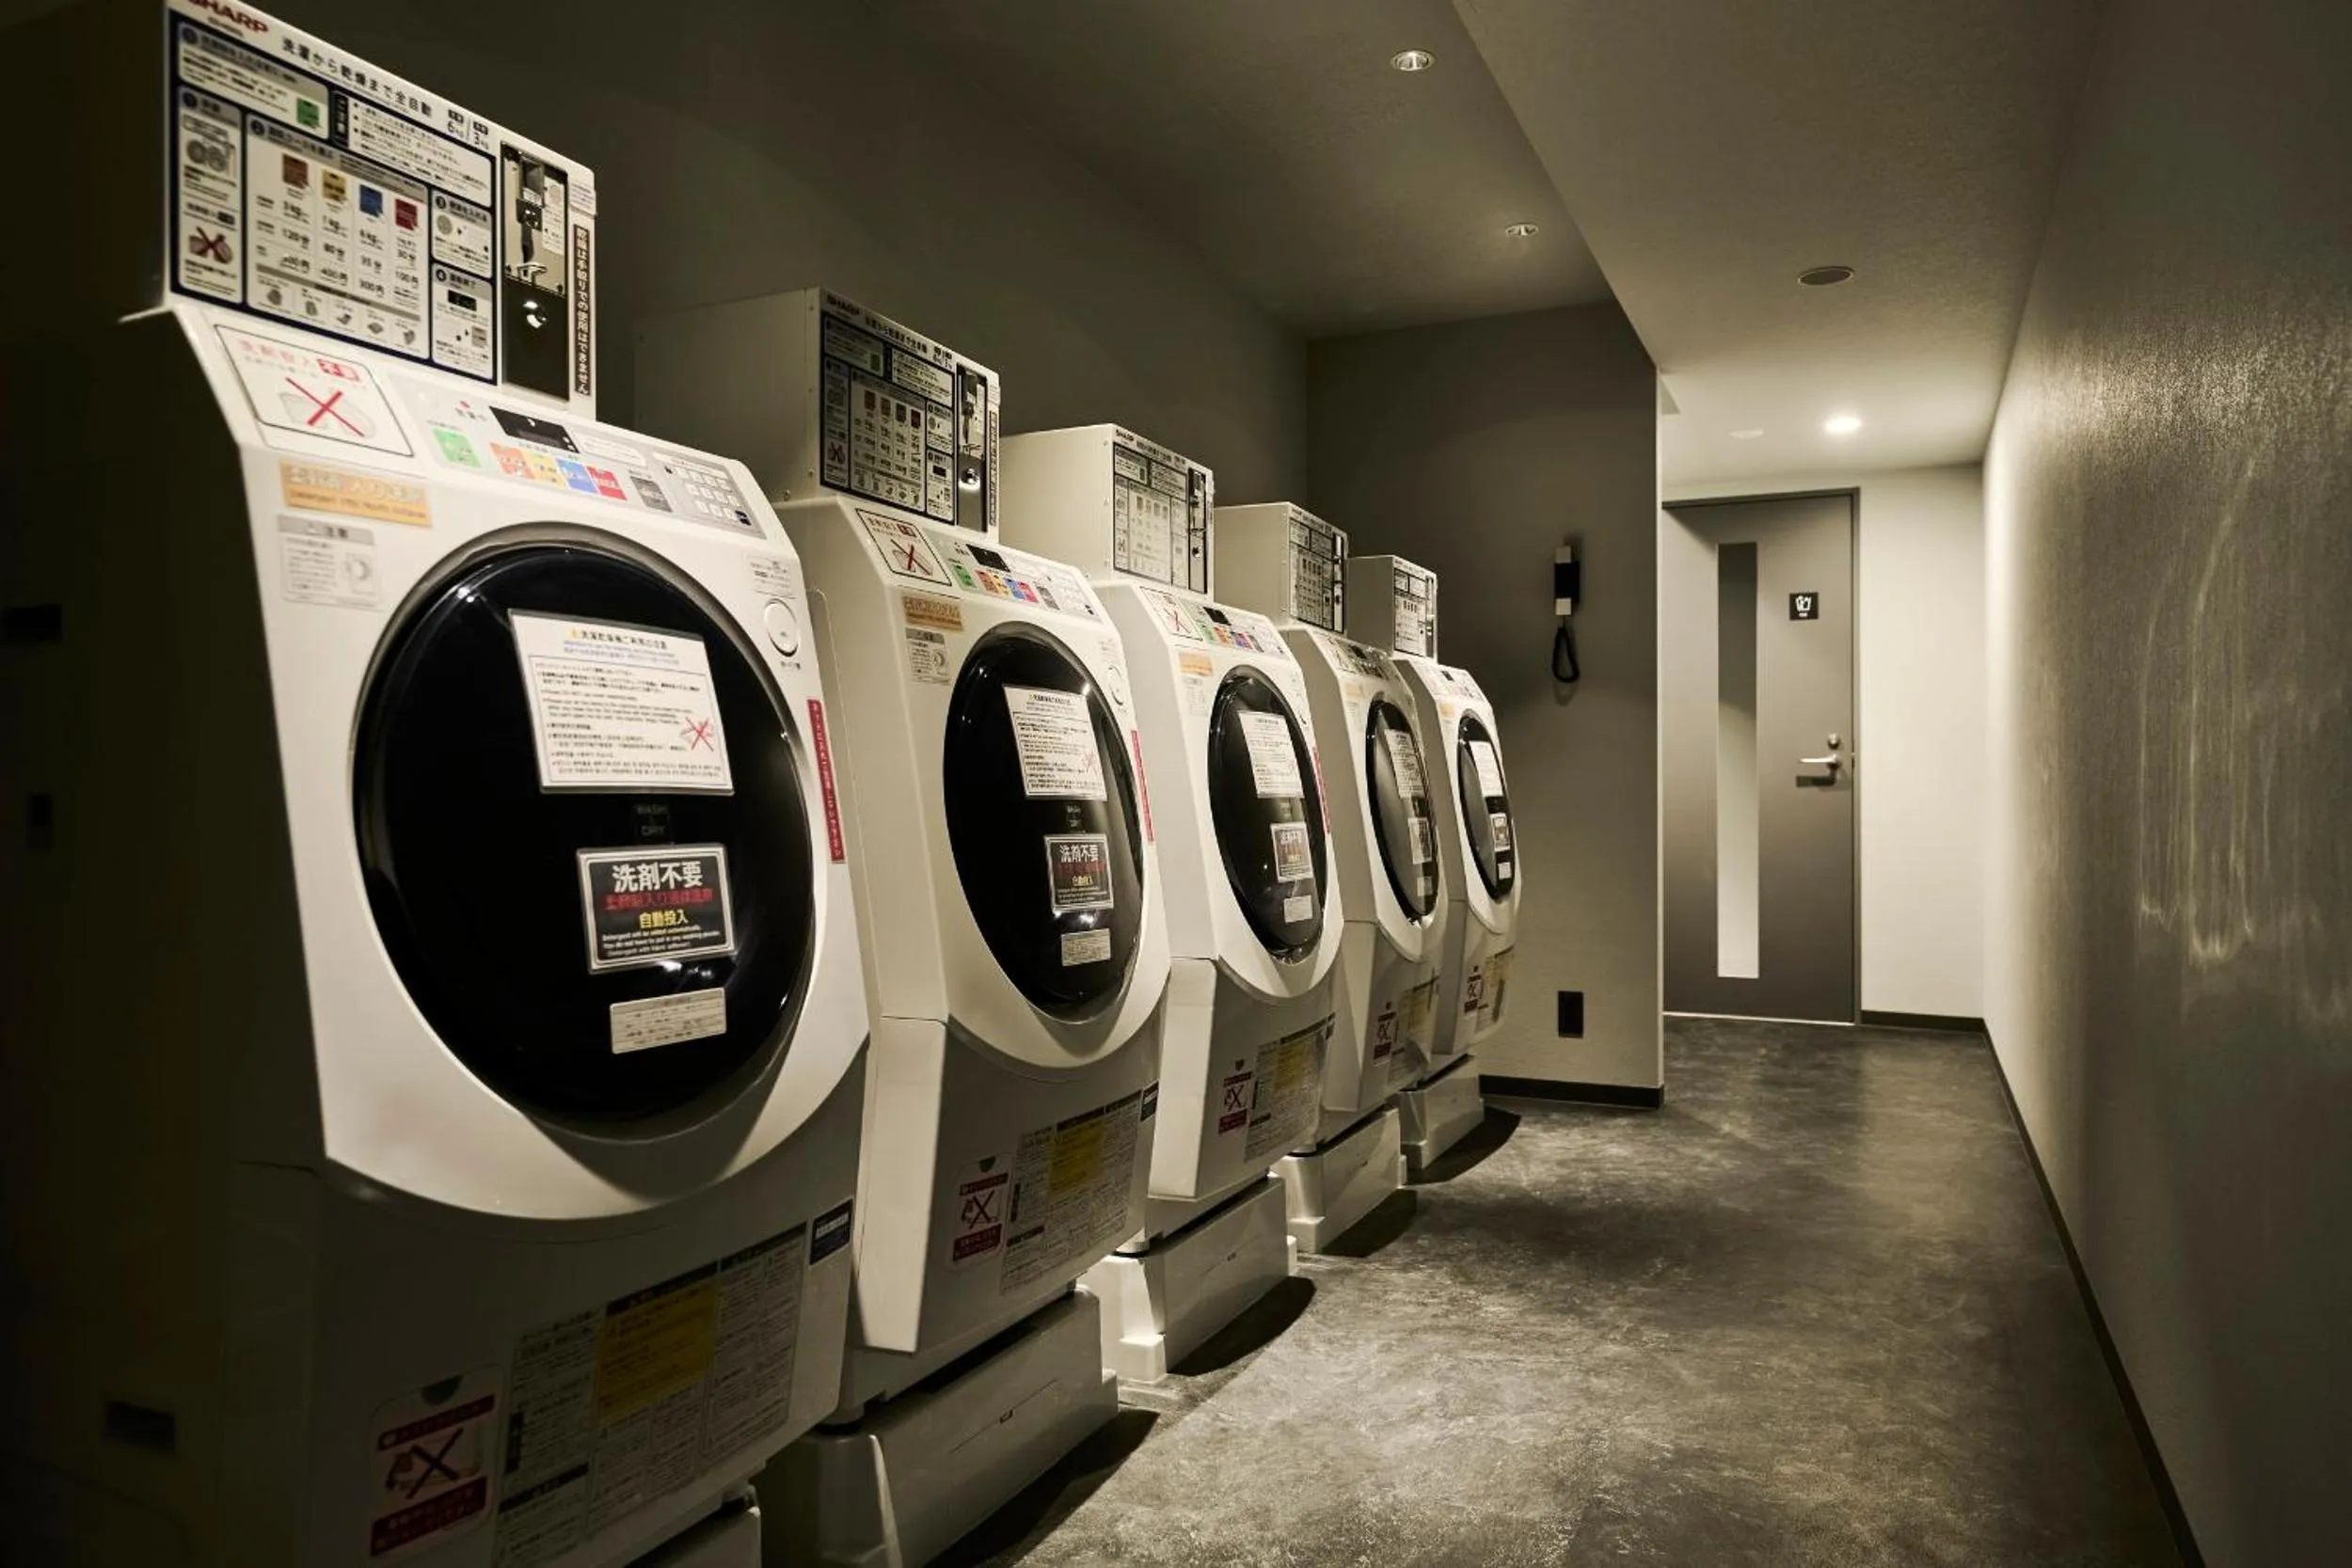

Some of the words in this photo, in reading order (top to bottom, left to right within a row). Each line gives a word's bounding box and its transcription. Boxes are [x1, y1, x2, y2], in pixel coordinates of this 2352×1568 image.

[1059, 844, 1099, 863] 洗剤不要
[612, 861, 704, 893] 洗剤不要
[639, 909, 689, 929] 自動投入
